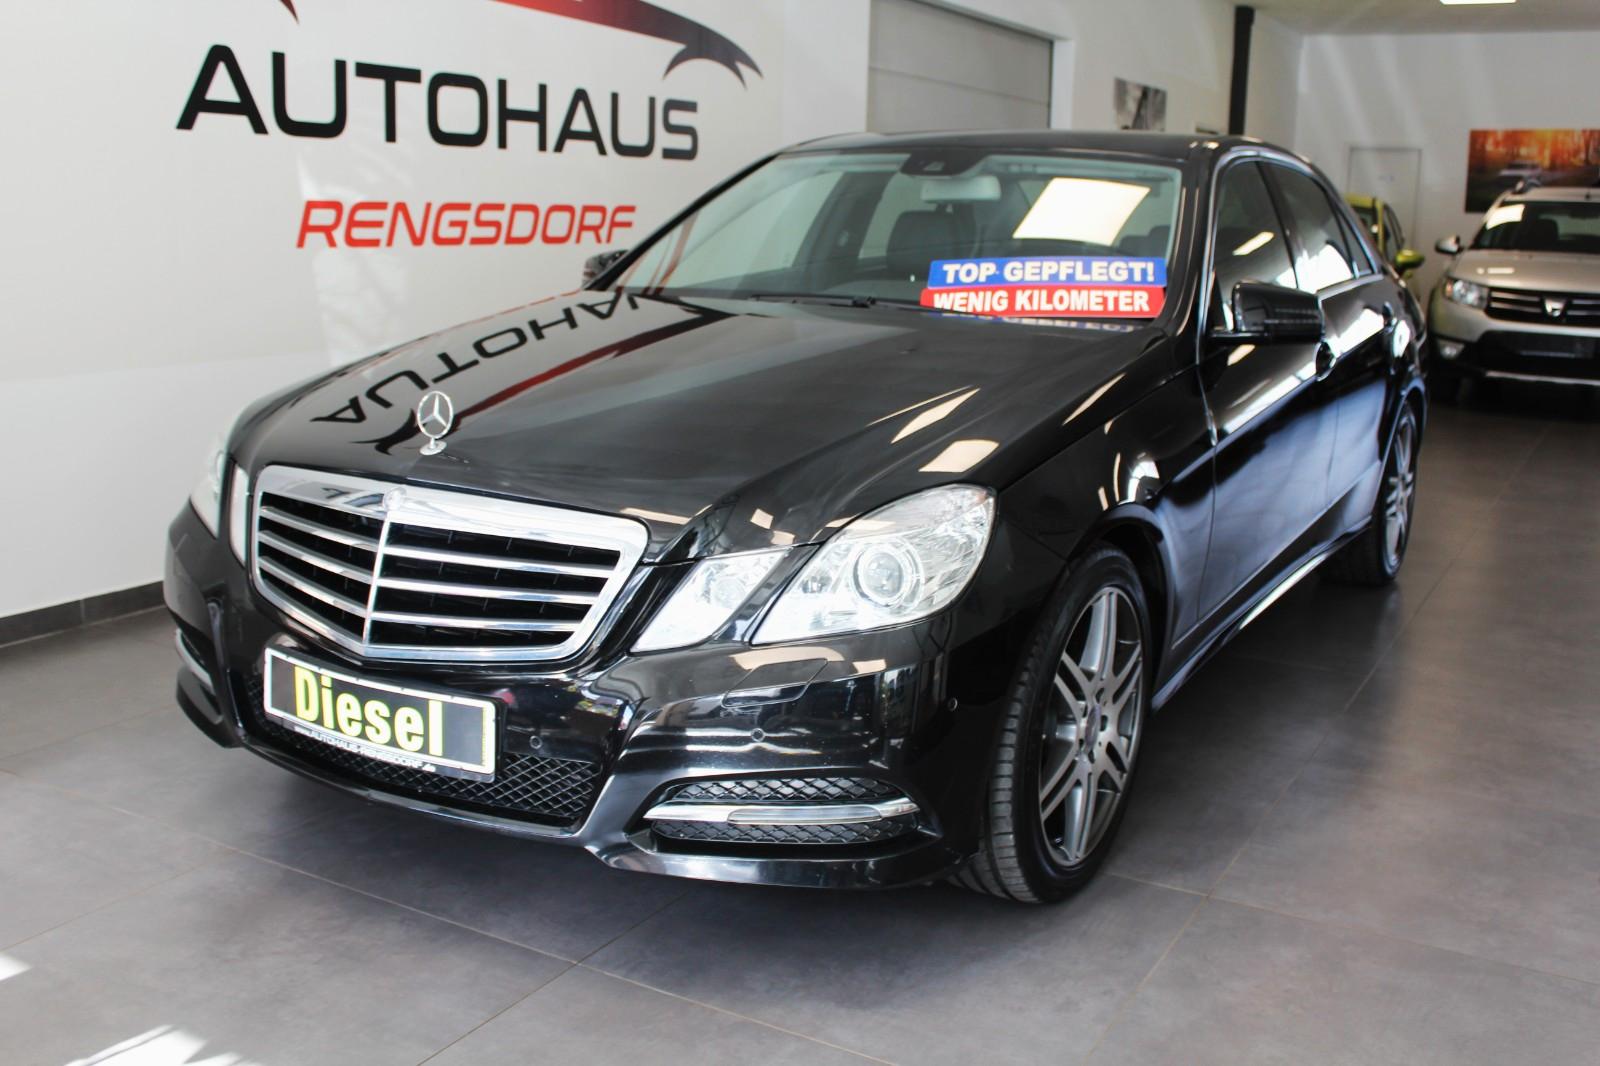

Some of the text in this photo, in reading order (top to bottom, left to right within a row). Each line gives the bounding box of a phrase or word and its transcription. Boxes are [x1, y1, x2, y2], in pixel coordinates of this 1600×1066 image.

[176, 44, 698, 160] AUTOHAUS
[296, 200, 635, 249] RENGSDORF
[943, 261, 1155, 284] TOP GEPFLEGT!
[934, 289, 1150, 313] WENIG KILOMETER
[294, 666, 443, 757] Diesel
